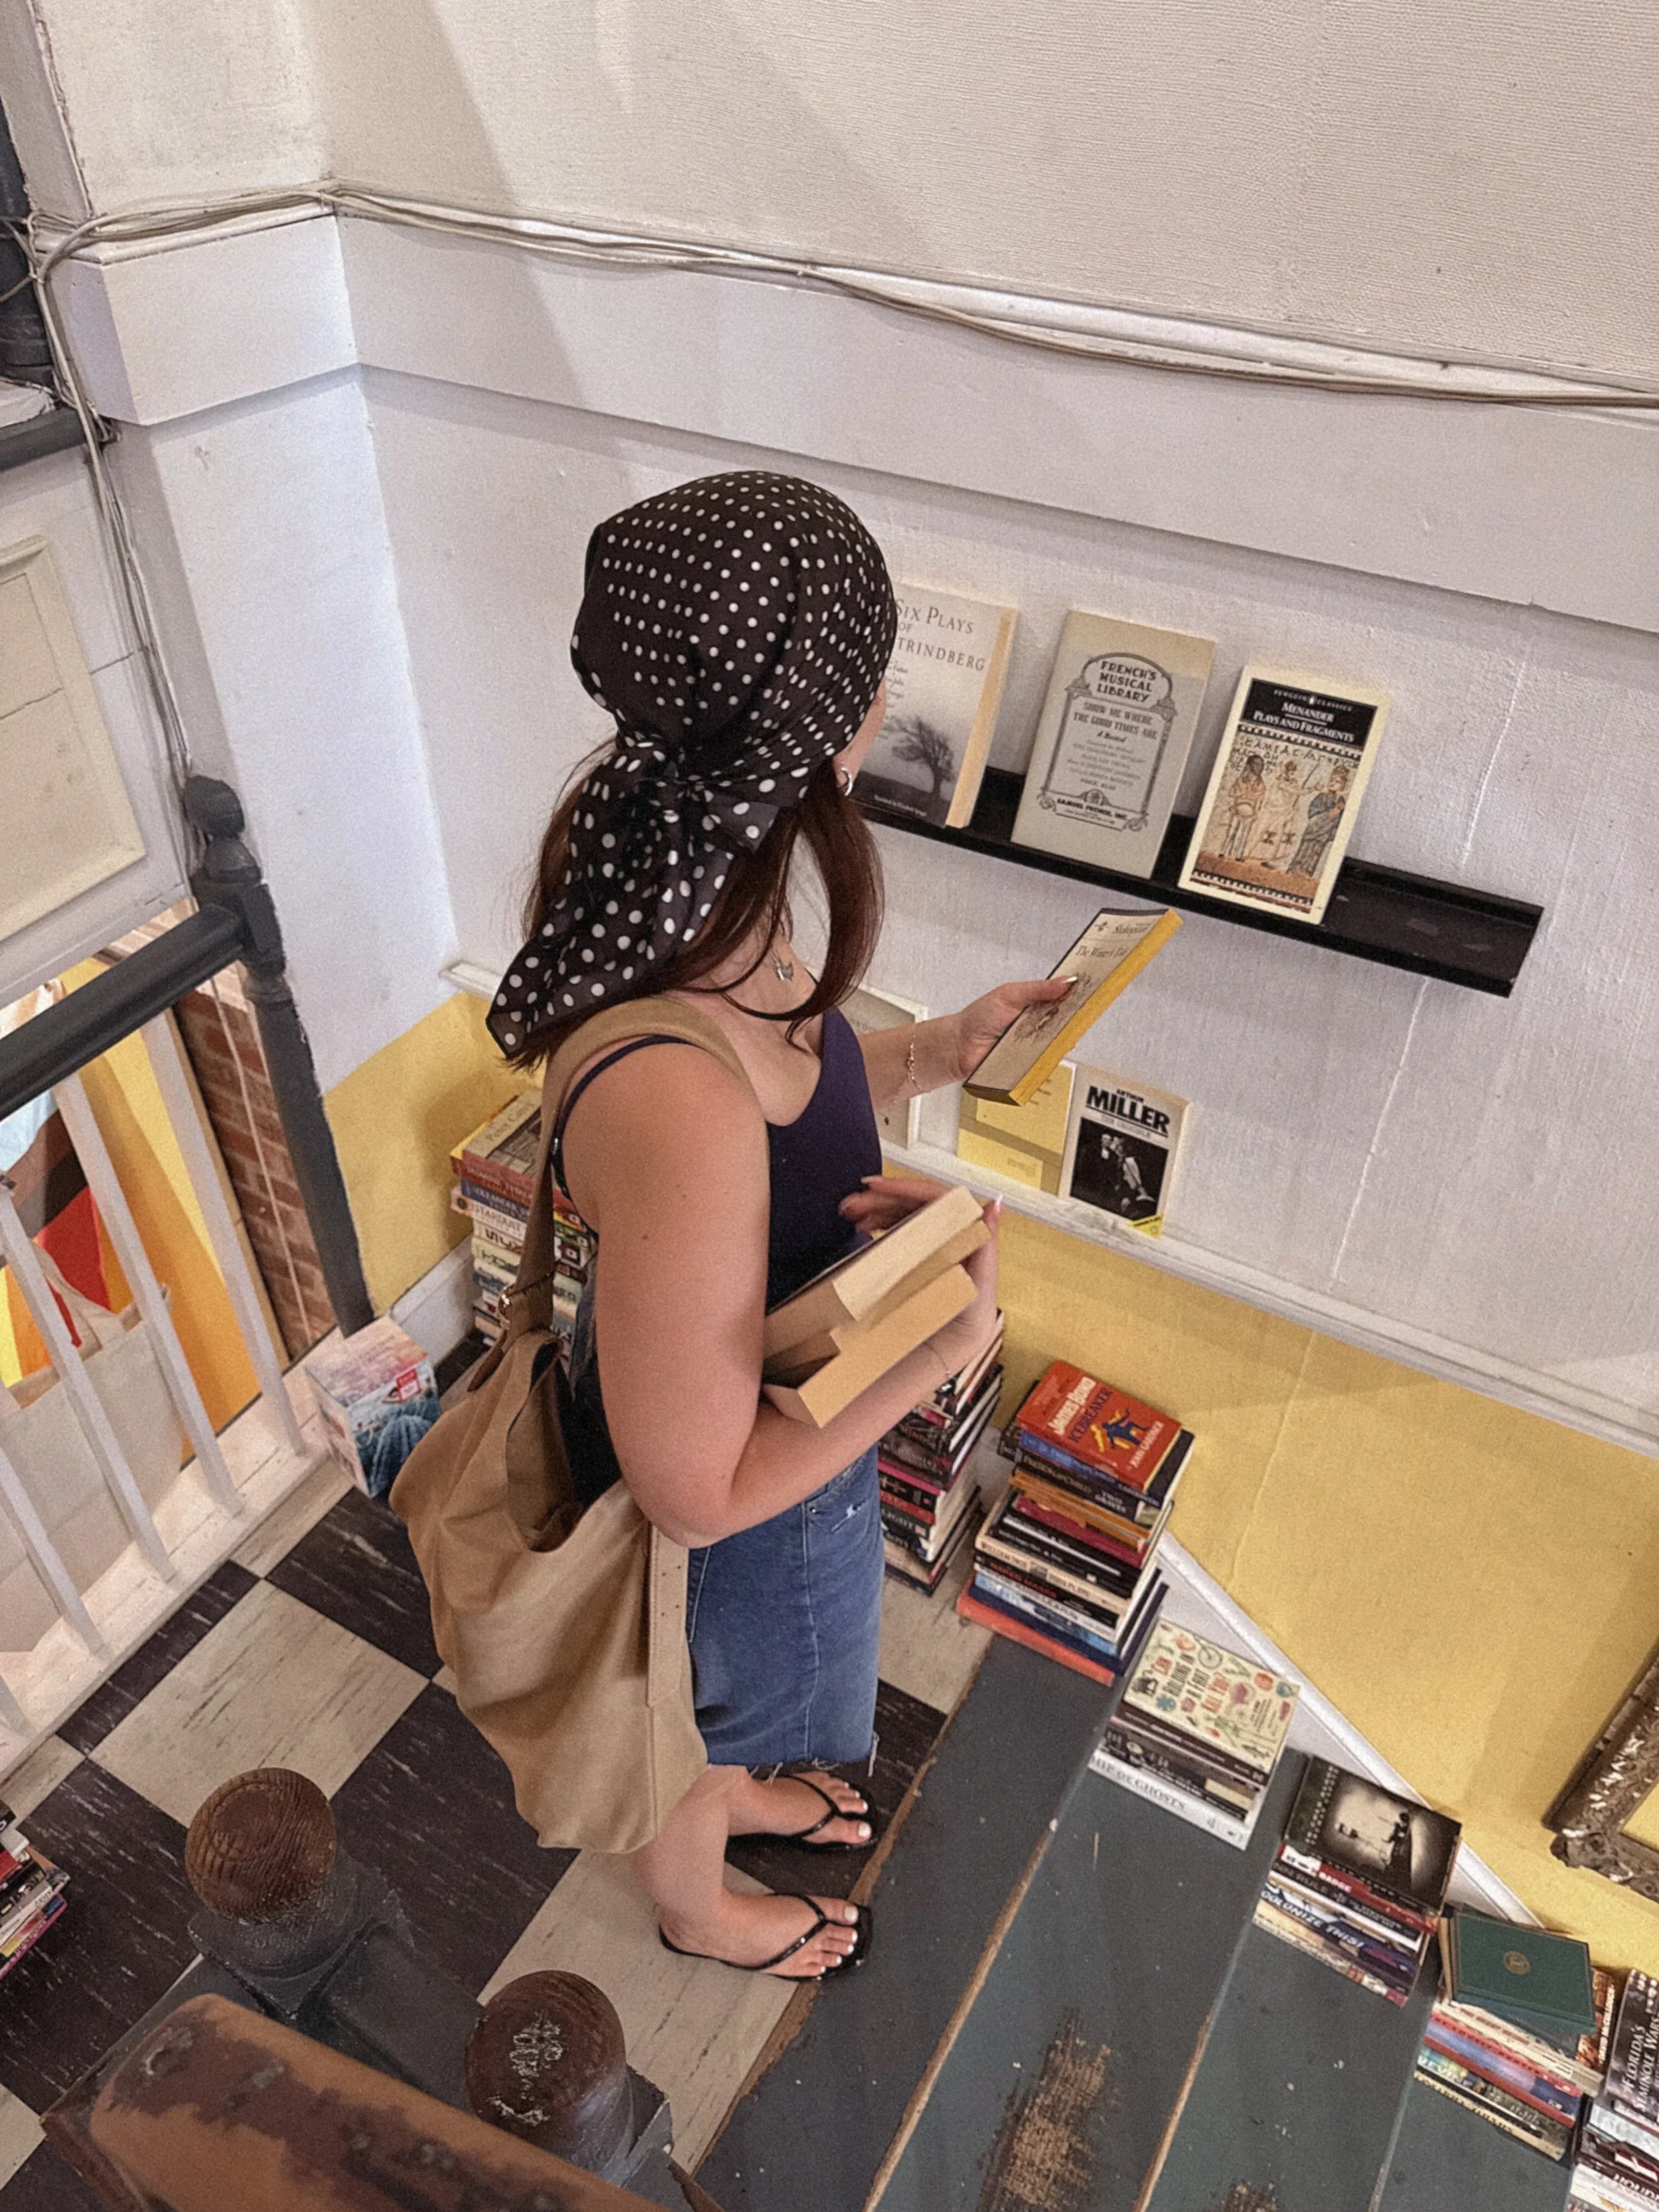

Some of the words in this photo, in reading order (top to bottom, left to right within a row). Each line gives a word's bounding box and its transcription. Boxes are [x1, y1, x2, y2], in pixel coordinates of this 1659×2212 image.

[899, 622, 914, 632] OF
[927, 606, 974, 634] PLAYS
[898, 637, 985, 671] TRINDBERG
[1099, 672, 1153, 692] MUSICAL
[1101, 661, 1157, 681] FRENCH'S
[1097, 684, 1149, 703] LIBRARY
[1273, 690, 1307, 702] PENGUIN
[1317, 698, 1352, 712] CLASSICS
[1073, 711, 1089, 723] THE
[1253, 710, 1280, 727] PLAYS
[1278, 717, 1301, 730] AND
[1300, 721, 1354, 743] FRAGMENTS
[1281, 702, 1334, 723] MENANDER
[1086, 1085, 1171, 1134] MILLER
[1047, 1398, 1081, 1436] JAMES
[1068, 1388, 1114, 1443] ICEBREAKER
[1133, 1780, 1186, 1811] GHOSTS
[1261, 1889, 1325, 1929] COLONIZE
[1325, 1925, 1366, 1948] THIS!
[1598, 2035, 1608, 2063] DAVID
[1622, 2025, 1646, 2091] FLORIDA'S
[1632, 2050, 1656, 2112] SEMINOLE
